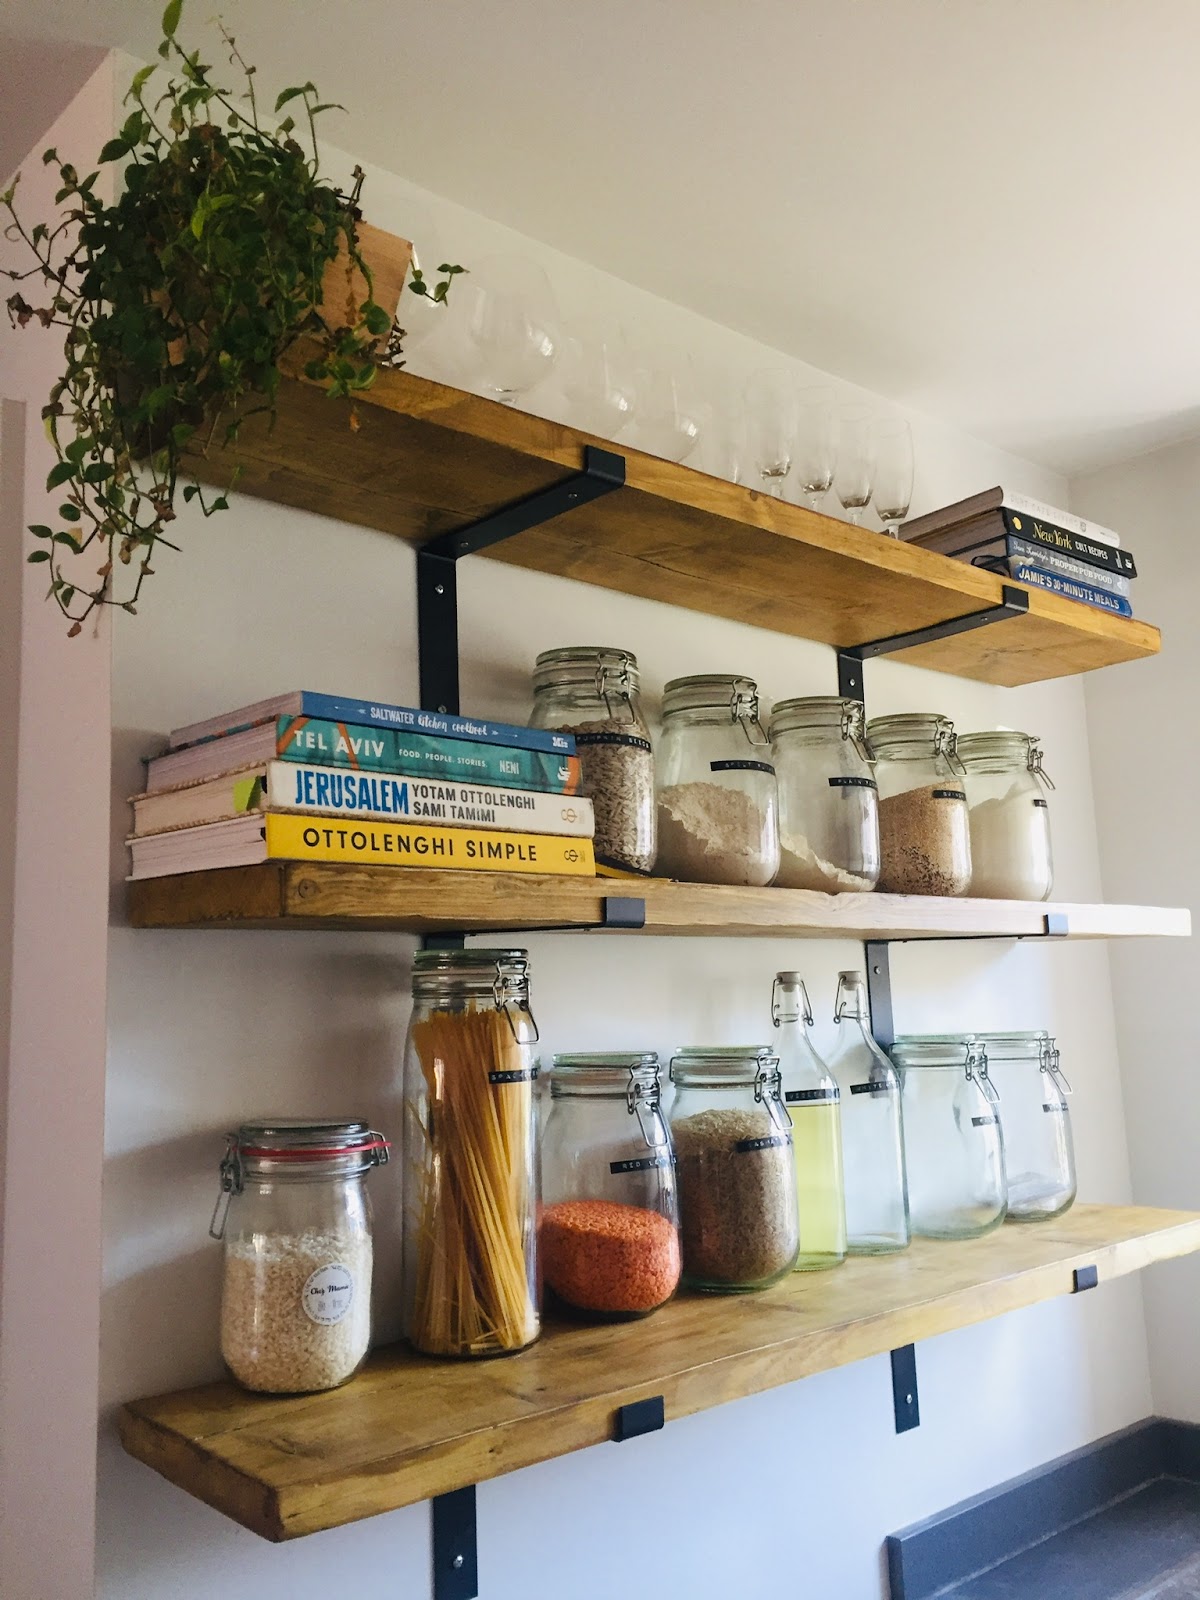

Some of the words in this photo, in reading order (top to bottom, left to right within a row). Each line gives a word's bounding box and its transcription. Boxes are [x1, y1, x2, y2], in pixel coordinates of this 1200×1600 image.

[1032, 522, 1055, 543] New
[1054, 530, 1073, 550] York
[1075, 541, 1087, 553] CULT
[1088, 545, 1108, 560] RECIPES
[1050, 557, 1079, 573] PROPER
[1079, 565, 1094, 578] PUB
[1094, 573, 1113, 585] FOOD
[1018, 568, 1052, 588] JAMIE'S
[1053, 581, 1093, 601] 30-MINUTE
[1094, 592, 1120, 609] MEALS
[370, 707, 414, 725] SALTWATER
[294, 730, 328, 750] TEL
[336, 736, 384, 757] AVIV
[457, 757, 488, 768] STORIES.
[499, 760, 520, 775] NENI
[295, 770, 409, 815] JERUSALEM
[412, 784, 456, 802] YOTAM
[460, 789, 535, 810] OTTOLENGHI
[413, 801, 446, 818] SAMI
[450, 807, 496, 823] TAMIMI
[303, 827, 454, 856] OTTOLENGHI
[466, 839, 537, 862] SIMPLE
[622, 1161, 641, 1169] RED
